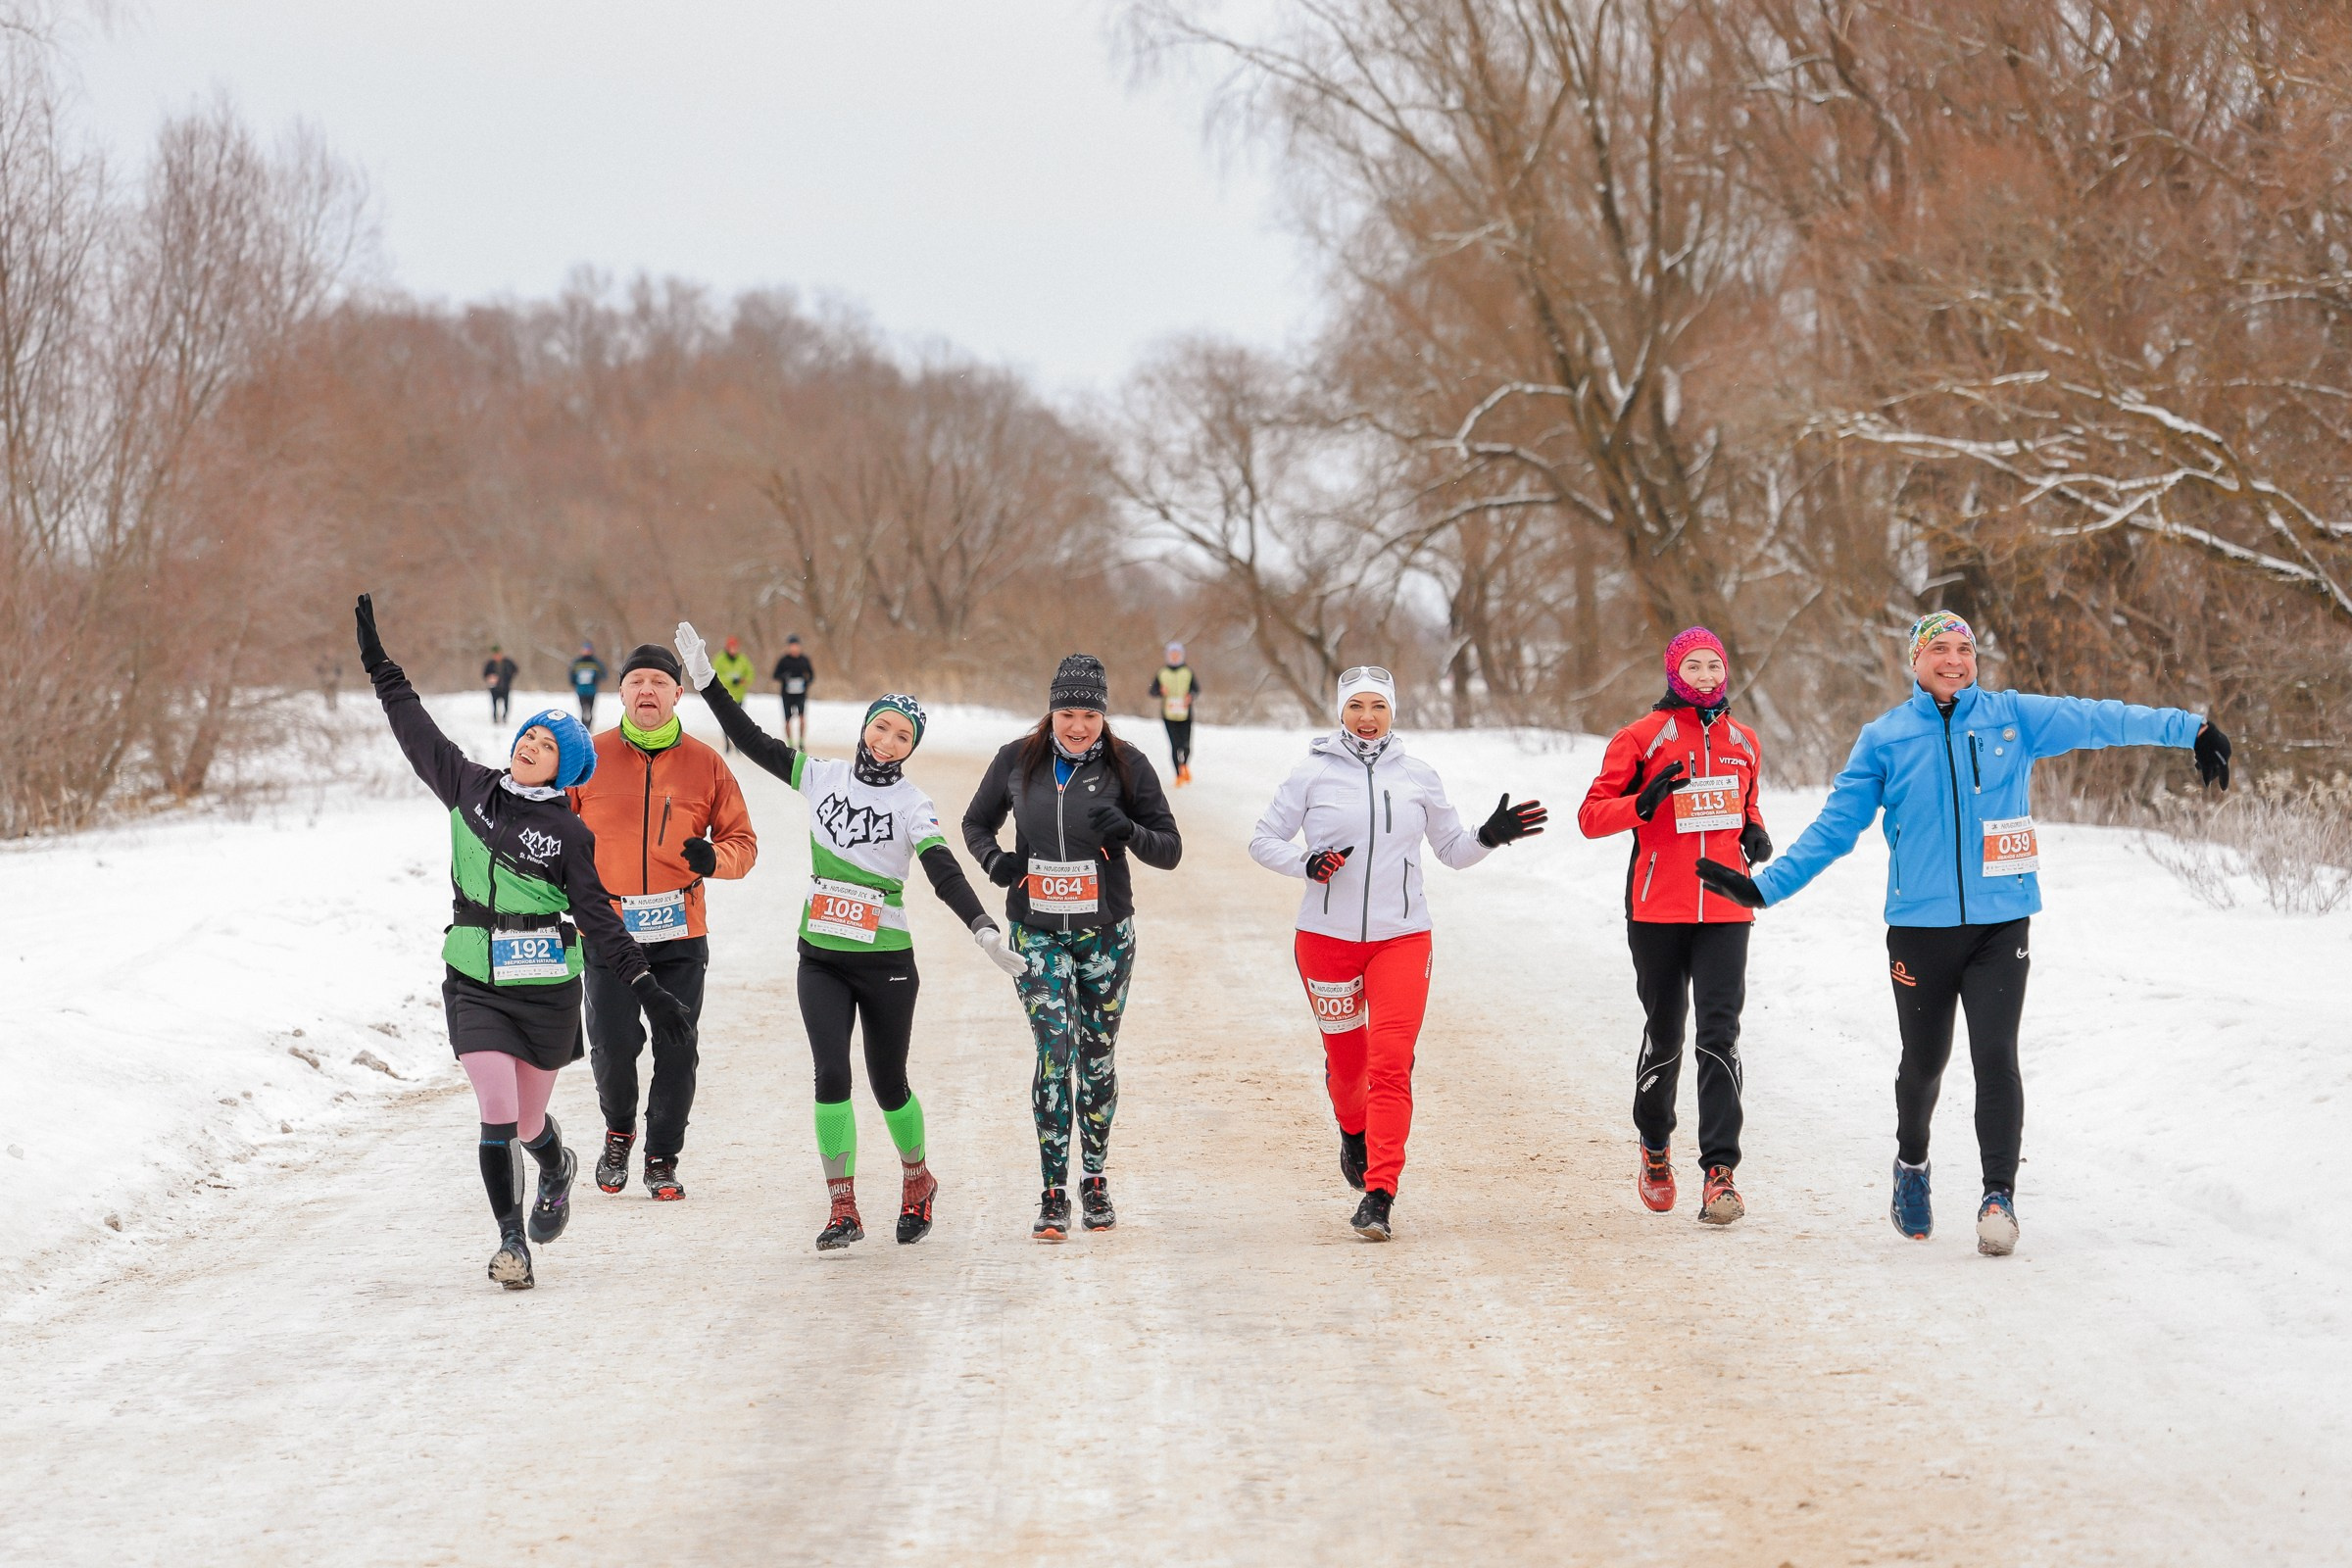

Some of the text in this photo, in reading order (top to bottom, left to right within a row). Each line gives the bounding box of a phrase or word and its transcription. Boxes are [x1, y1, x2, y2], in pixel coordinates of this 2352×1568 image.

[1690, 791, 1725, 811] 113
[1999, 832, 2031, 855] 039
[830, 885, 858, 895] NOVGOROD
[1042, 877, 1083, 896] 064
[638, 906, 674, 927] 222
[823, 898, 864, 921] 108
[510, 939, 551, 959] 192
[1317, 997, 1354, 1016] 008
